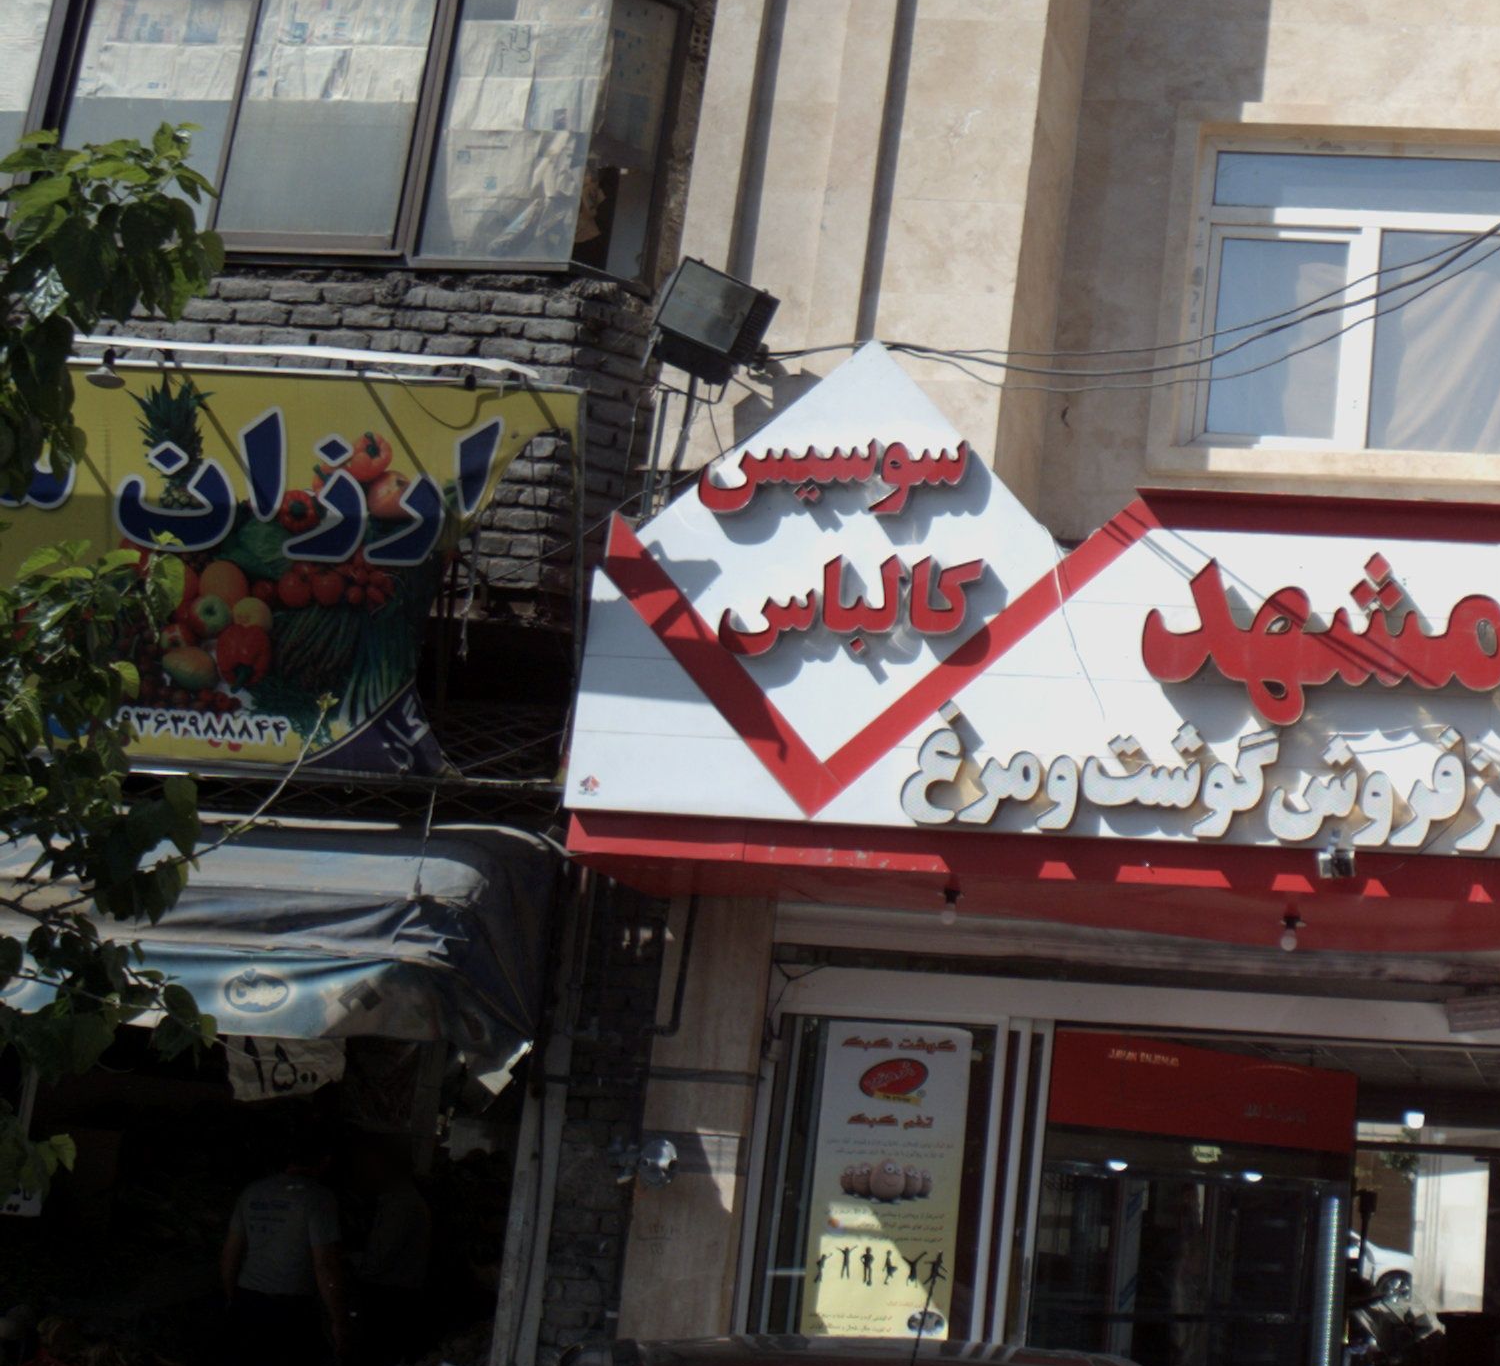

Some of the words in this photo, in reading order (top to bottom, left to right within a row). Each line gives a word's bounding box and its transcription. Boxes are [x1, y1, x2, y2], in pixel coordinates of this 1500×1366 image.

[118, 408, 502, 564] ارزان
[698, 438, 972, 514] سوسیس
[717, 553, 988, 657] کالباس
[899, 700, 1044, 826] مرغ
[1034, 752, 1081, 831] و
[1082, 720, 1281, 839] گوشت
[1267, 726, 1468, 848] فروش
